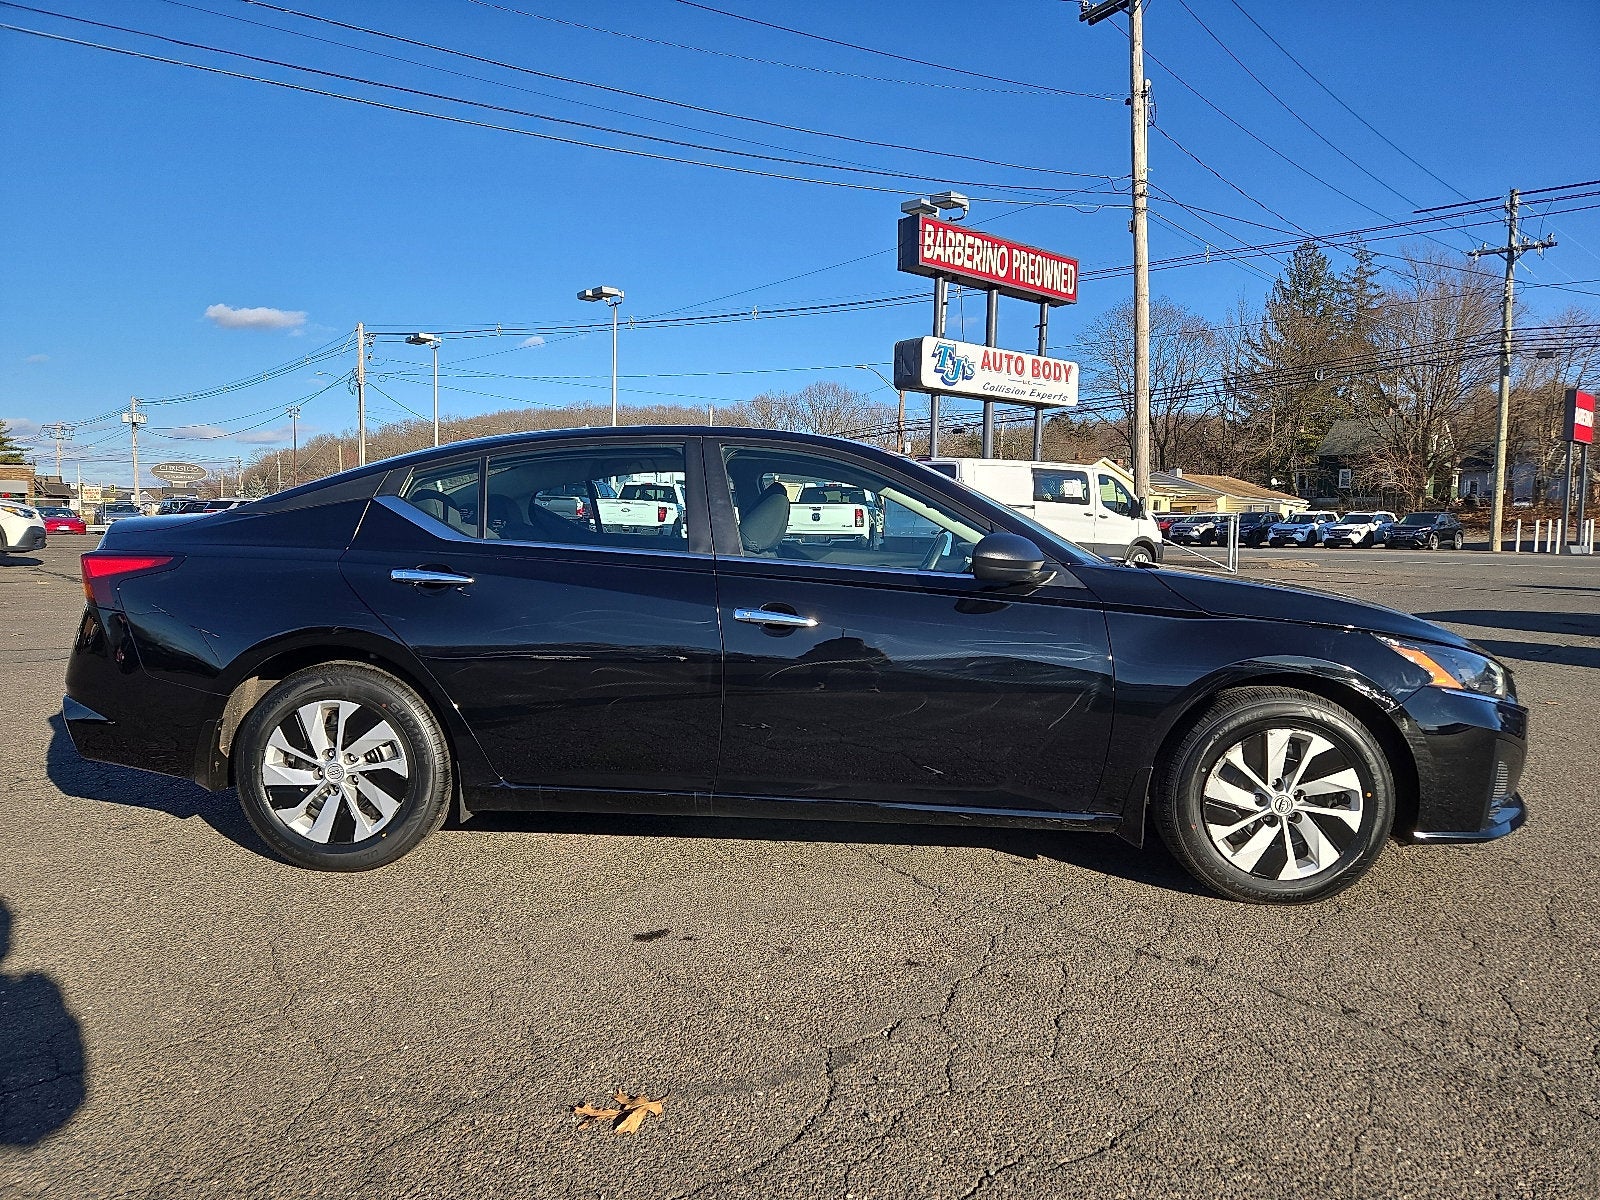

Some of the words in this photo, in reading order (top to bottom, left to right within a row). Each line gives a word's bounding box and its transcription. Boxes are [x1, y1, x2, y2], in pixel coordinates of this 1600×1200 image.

[923, 223, 1009, 278] BARBERINO
[1012, 248, 1076, 295] PREOWNED
[980, 349, 1026, 377] AUTO
[1031, 358, 1074, 384] BODY
[982, 382, 1027, 396] Collision
[1029, 388, 1069, 402] Experts
